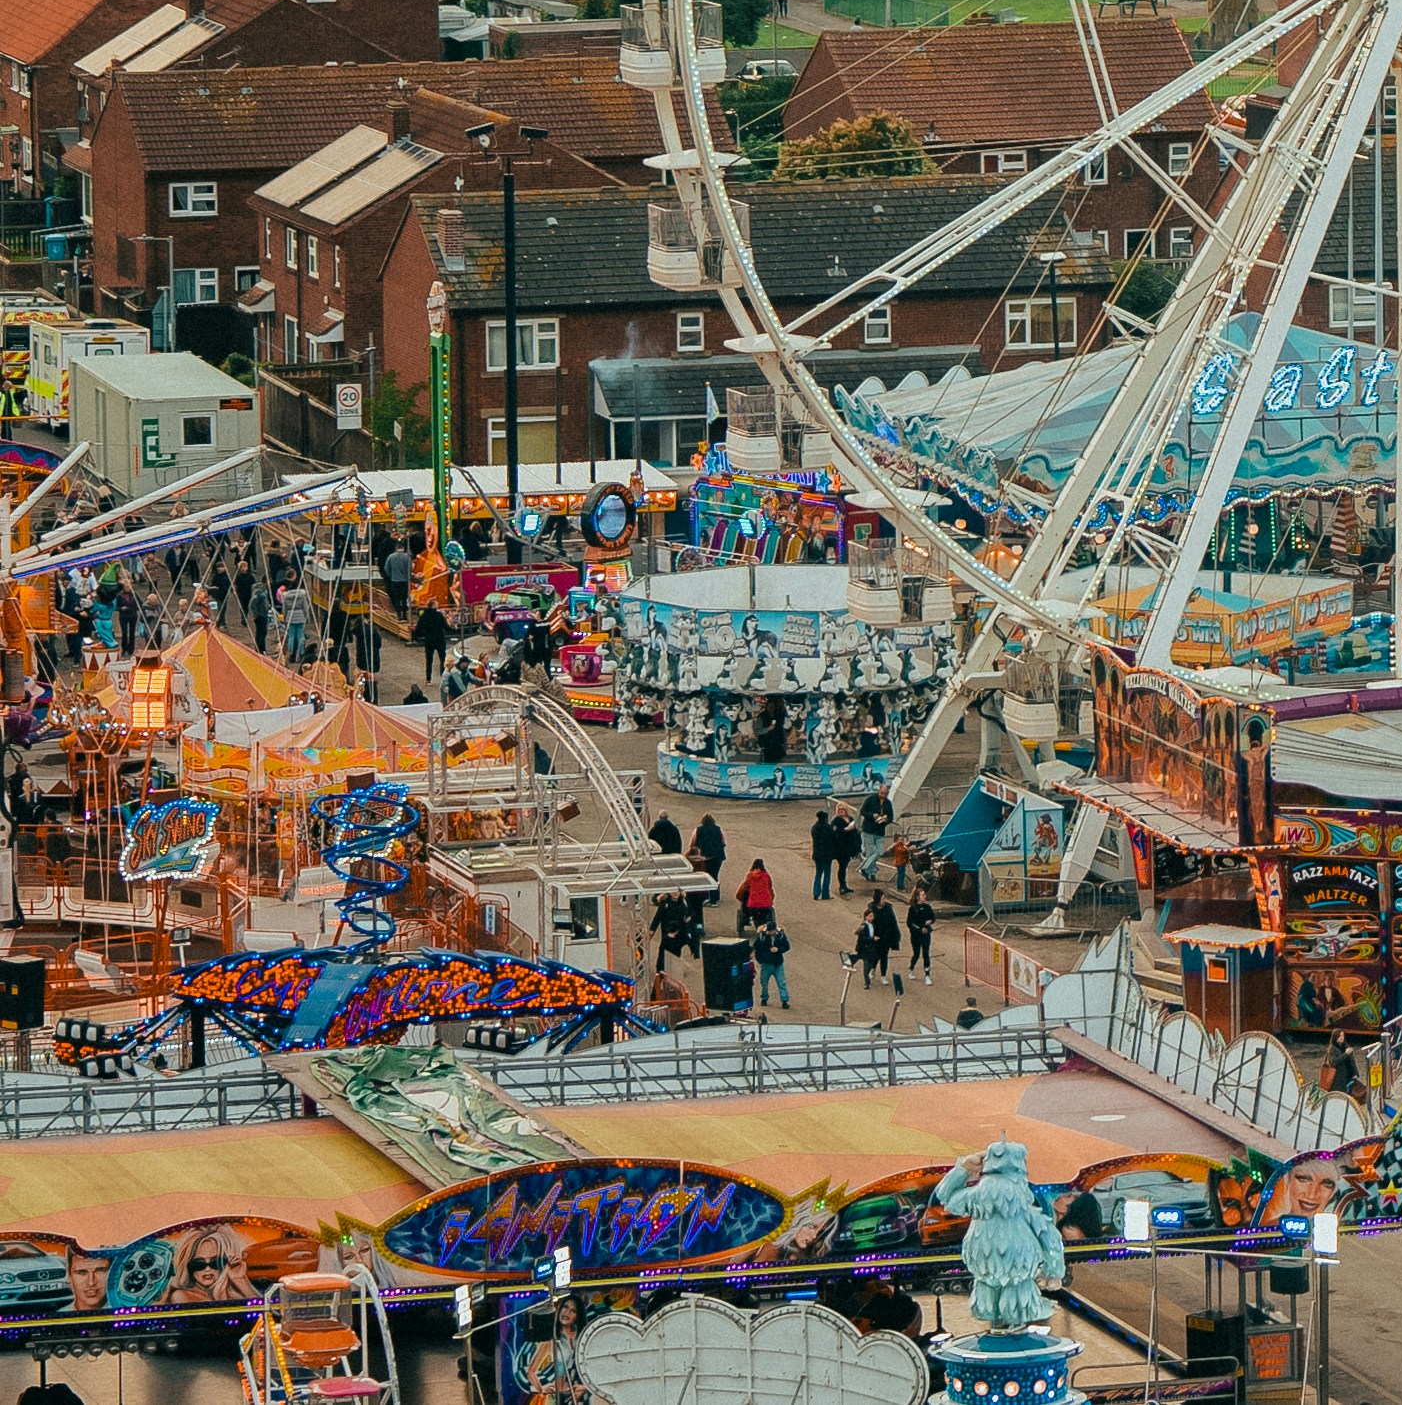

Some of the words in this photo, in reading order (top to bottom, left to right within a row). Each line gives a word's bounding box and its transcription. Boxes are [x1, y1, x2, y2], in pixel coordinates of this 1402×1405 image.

[1193, 352, 1303, 415] Sa
[341, 392, 356, 402] 20
[703, 625, 736, 653] 10
[1191, 627, 1222, 644] WIN
[274, 776, 316, 793] HOOK
[317, 774, 332, 789] A
[1292, 866, 1378, 889] RAZZAMATAZZ
[1304, 888, 1368, 907] WALTZER
